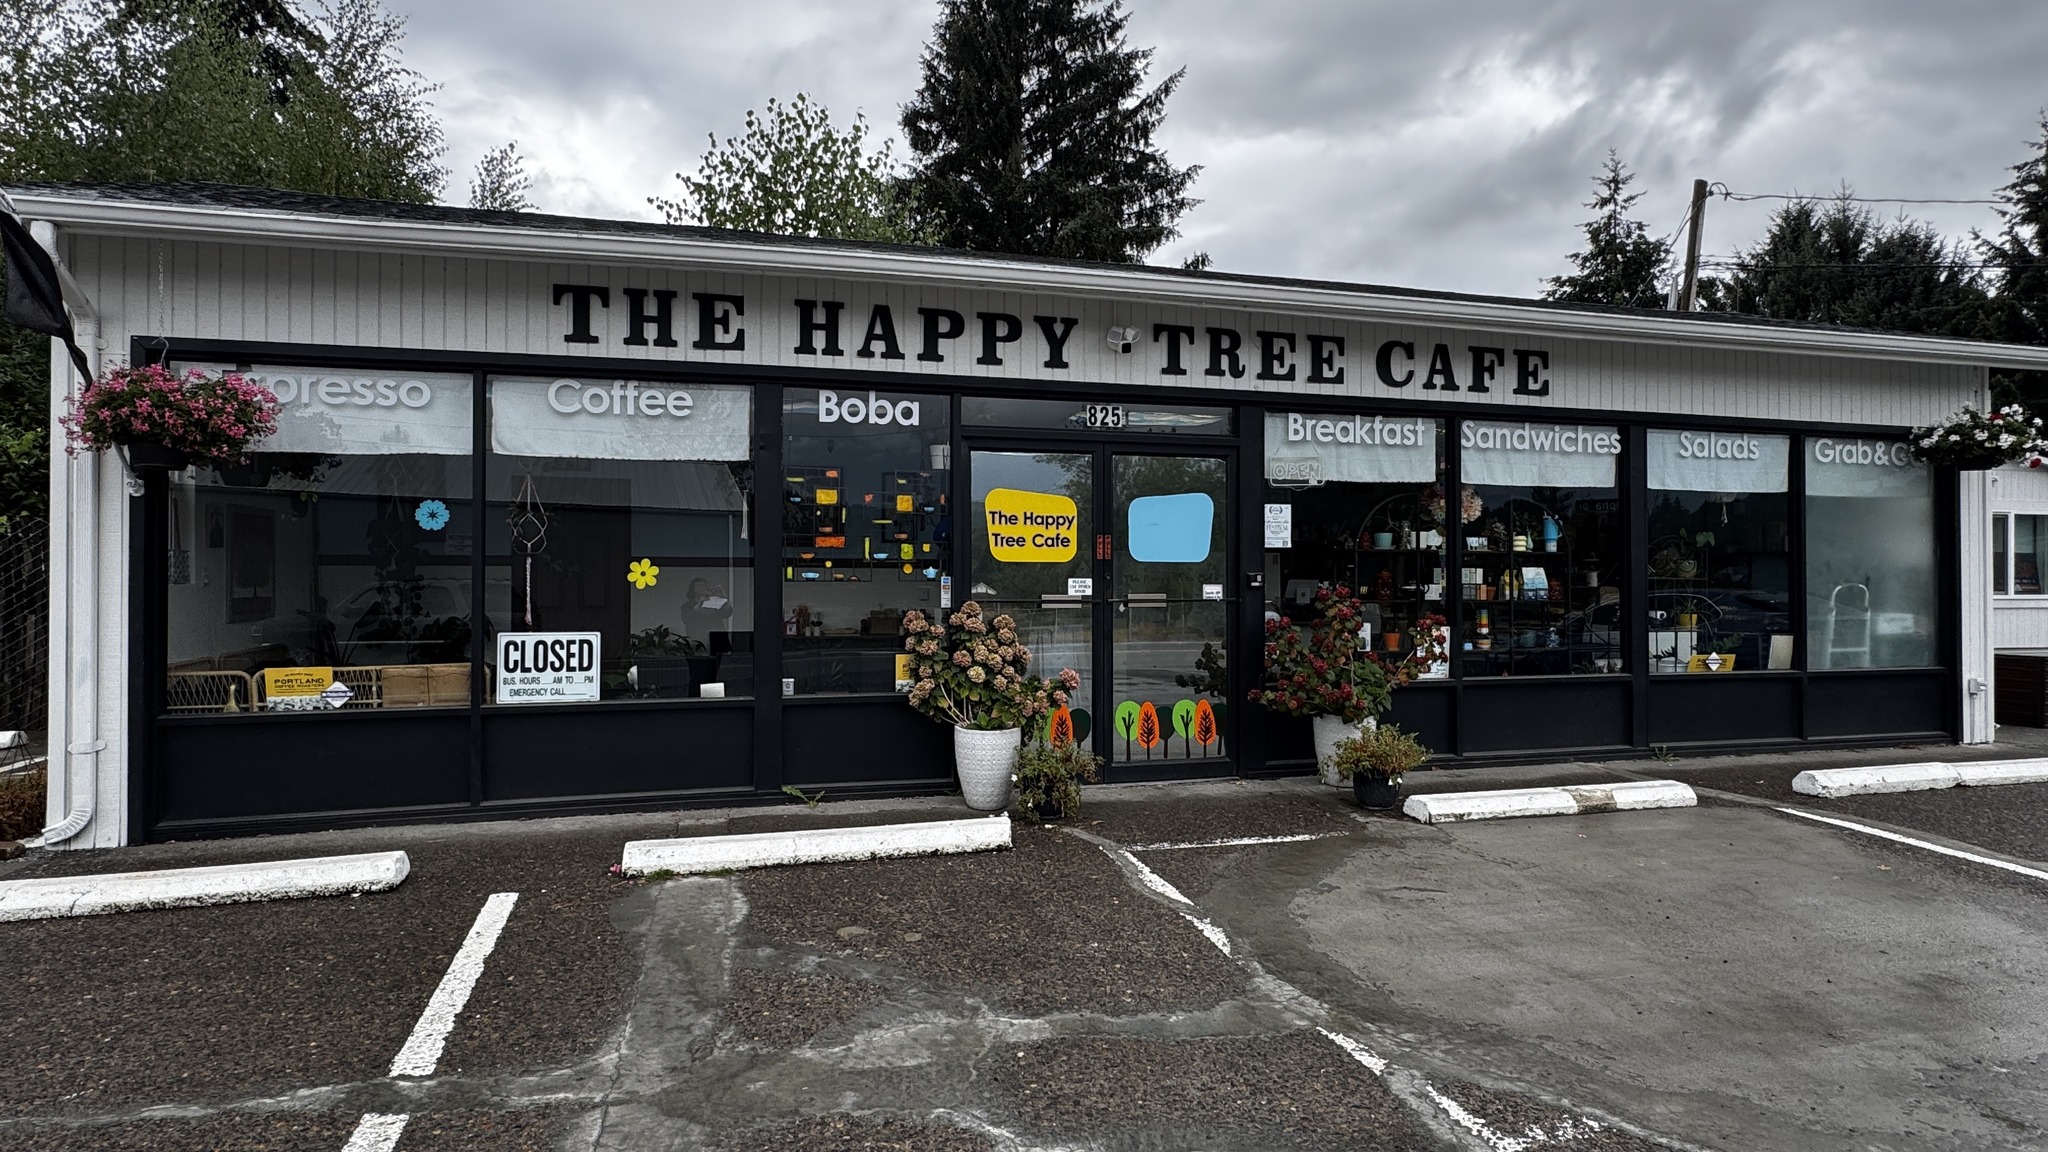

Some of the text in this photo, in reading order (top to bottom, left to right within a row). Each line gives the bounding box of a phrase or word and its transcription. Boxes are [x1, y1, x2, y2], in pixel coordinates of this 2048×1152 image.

[552, 283, 1552, 397] THE HAPPY TREE CAFE
[248, 373, 432, 409] presso
[547, 379, 694, 418] Coffee
[818, 390, 921, 427] Boba
[1088, 406, 1121, 426] 825
[1287, 412, 1425, 448] Breakfast
[1460, 419, 1622, 455] Sandwiches
[1678, 430, 1761, 460] Salads
[1273, 463, 1321, 480] OPEN
[988, 511, 1076, 531] The Happy
[991, 532, 1071, 548] Tree Cafe
[504, 639, 594, 674] CLOSED
[503, 675, 594, 686] BUS. HOURS AM TO PM
[509, 687, 566, 697] EMERGENCY CALL
